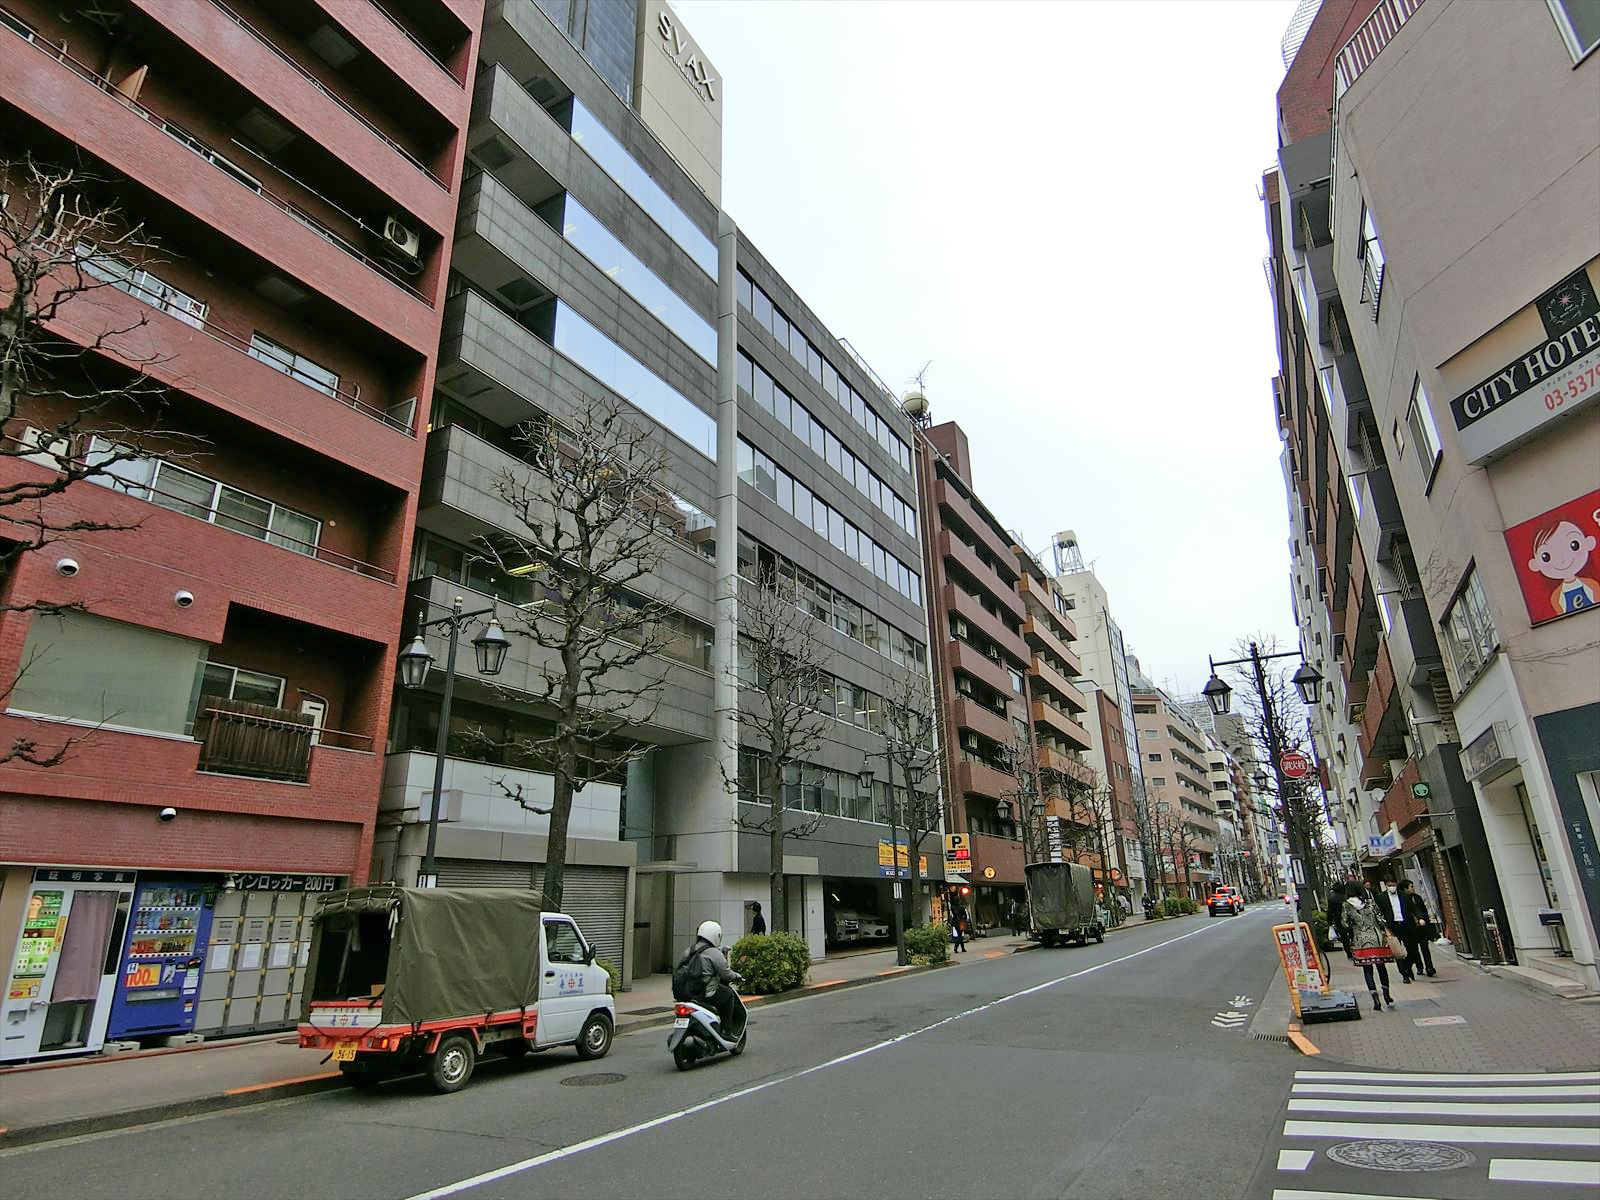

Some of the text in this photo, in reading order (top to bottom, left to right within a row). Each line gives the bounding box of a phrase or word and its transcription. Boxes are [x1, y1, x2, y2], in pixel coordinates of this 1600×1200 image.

[658, 11, 715, 101] SVAX
[1463, 366, 1519, 418] CITY
[1283, 760, 1306, 771] 消火栓
[952, 836, 962, 848] P
[225, 873, 335, 891] インロッカー 200円
